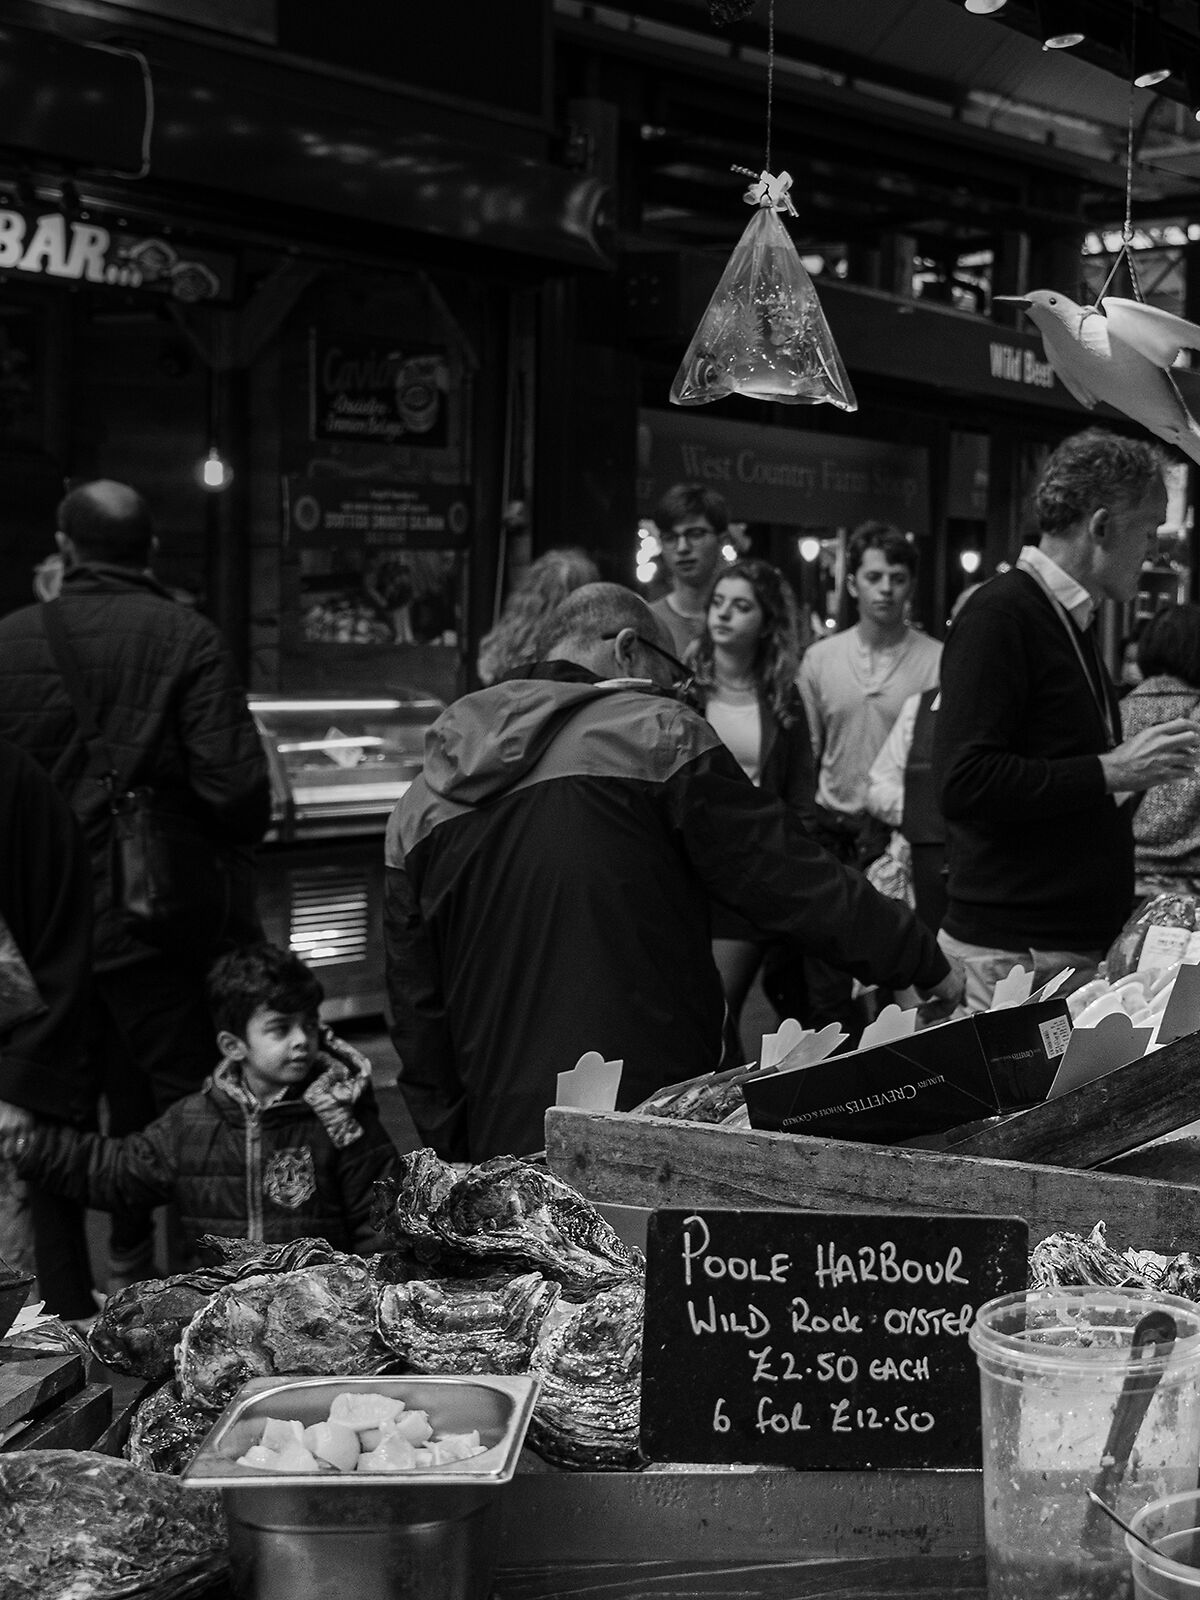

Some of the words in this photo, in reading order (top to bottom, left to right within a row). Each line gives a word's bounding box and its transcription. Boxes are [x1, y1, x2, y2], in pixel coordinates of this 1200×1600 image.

[322, 346, 400, 394] Cavia
[989, 341, 1022, 382] Wild
[681, 443, 730, 480] West
[736, 449, 815, 497] Country
[845, 1084, 917, 1115] CREVETTES
[918, 1075, 945, 1089] LUXURY
[682, 1216, 790, 1285] POOLE
[814, 1240, 970, 1289] HARBOUR
[687, 1296, 771, 1338] WILD
[884, 1303, 974, 1336] OYSTER
[748, 1345, 858, 1383] £2.50
[868, 1355, 930, 1381] EACH
[712, 1398, 732, 1433] 6
[830, 1398, 936, 1433] £12.50
